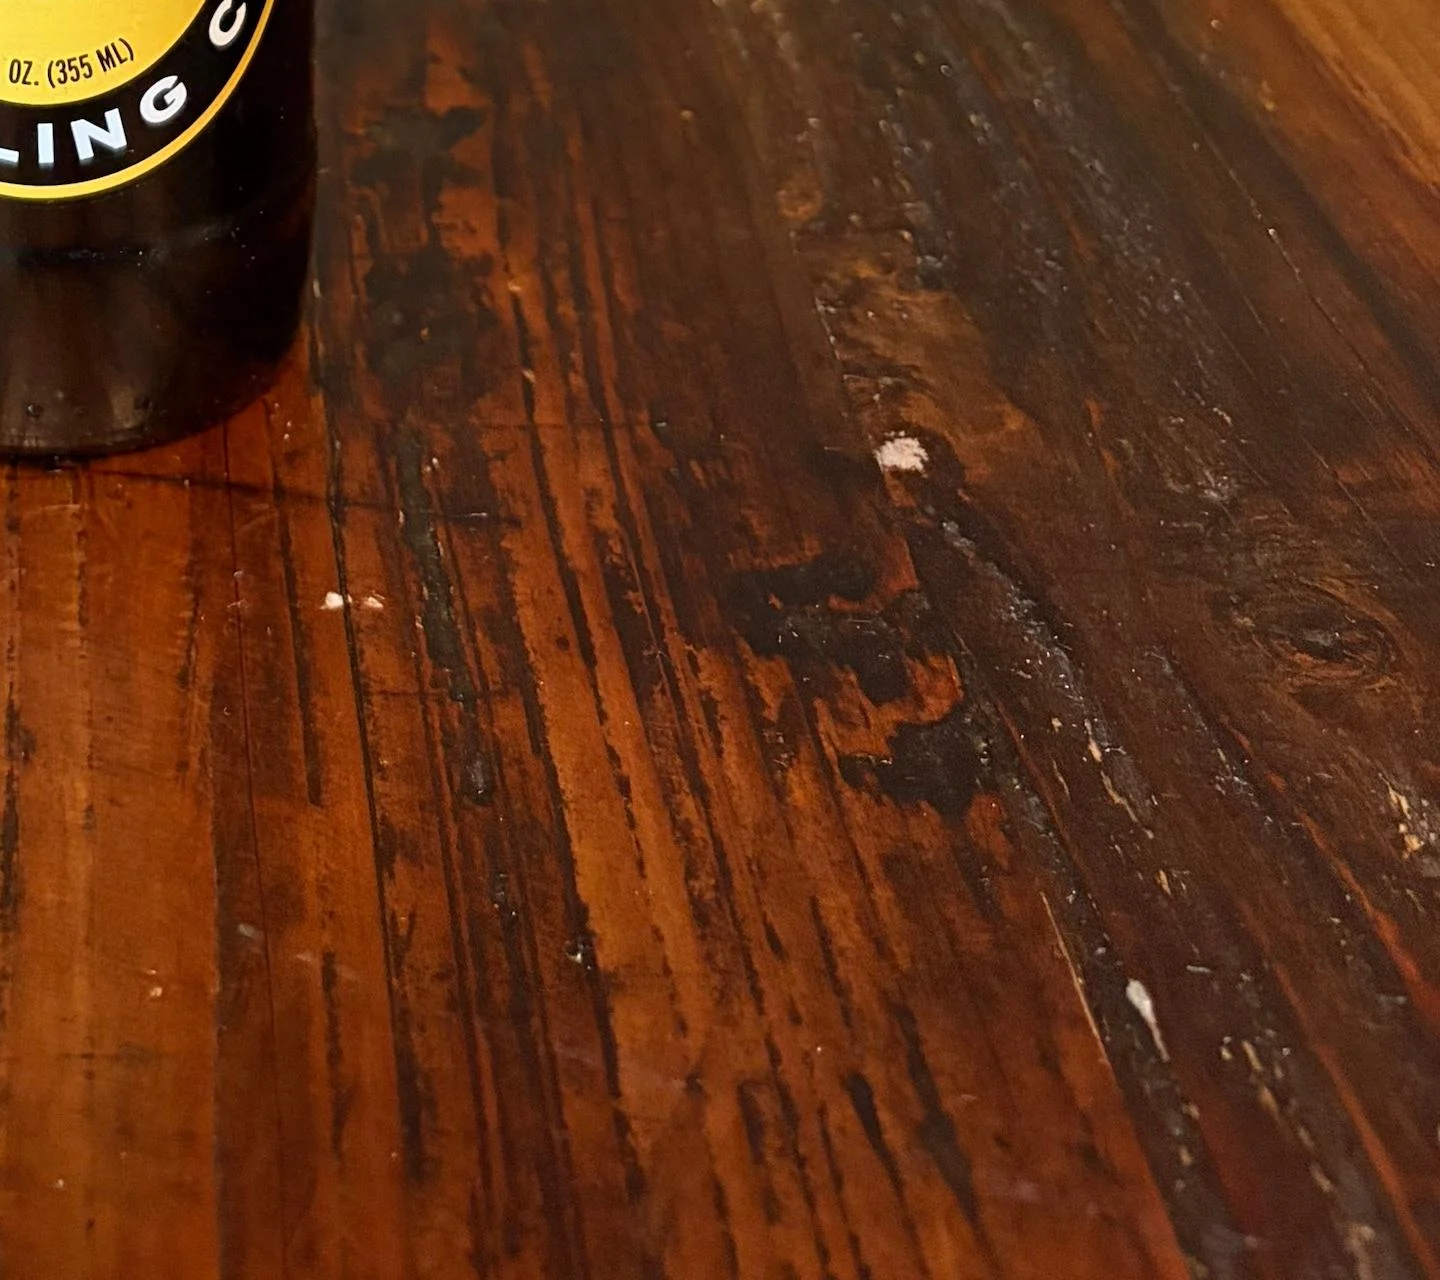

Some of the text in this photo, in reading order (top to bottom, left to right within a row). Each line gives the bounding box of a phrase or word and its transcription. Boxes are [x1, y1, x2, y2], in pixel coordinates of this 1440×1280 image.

[8, 58, 39, 86] OZ.
[47, 54, 93, 88] (355
[96, 37, 135, 73] ML)
